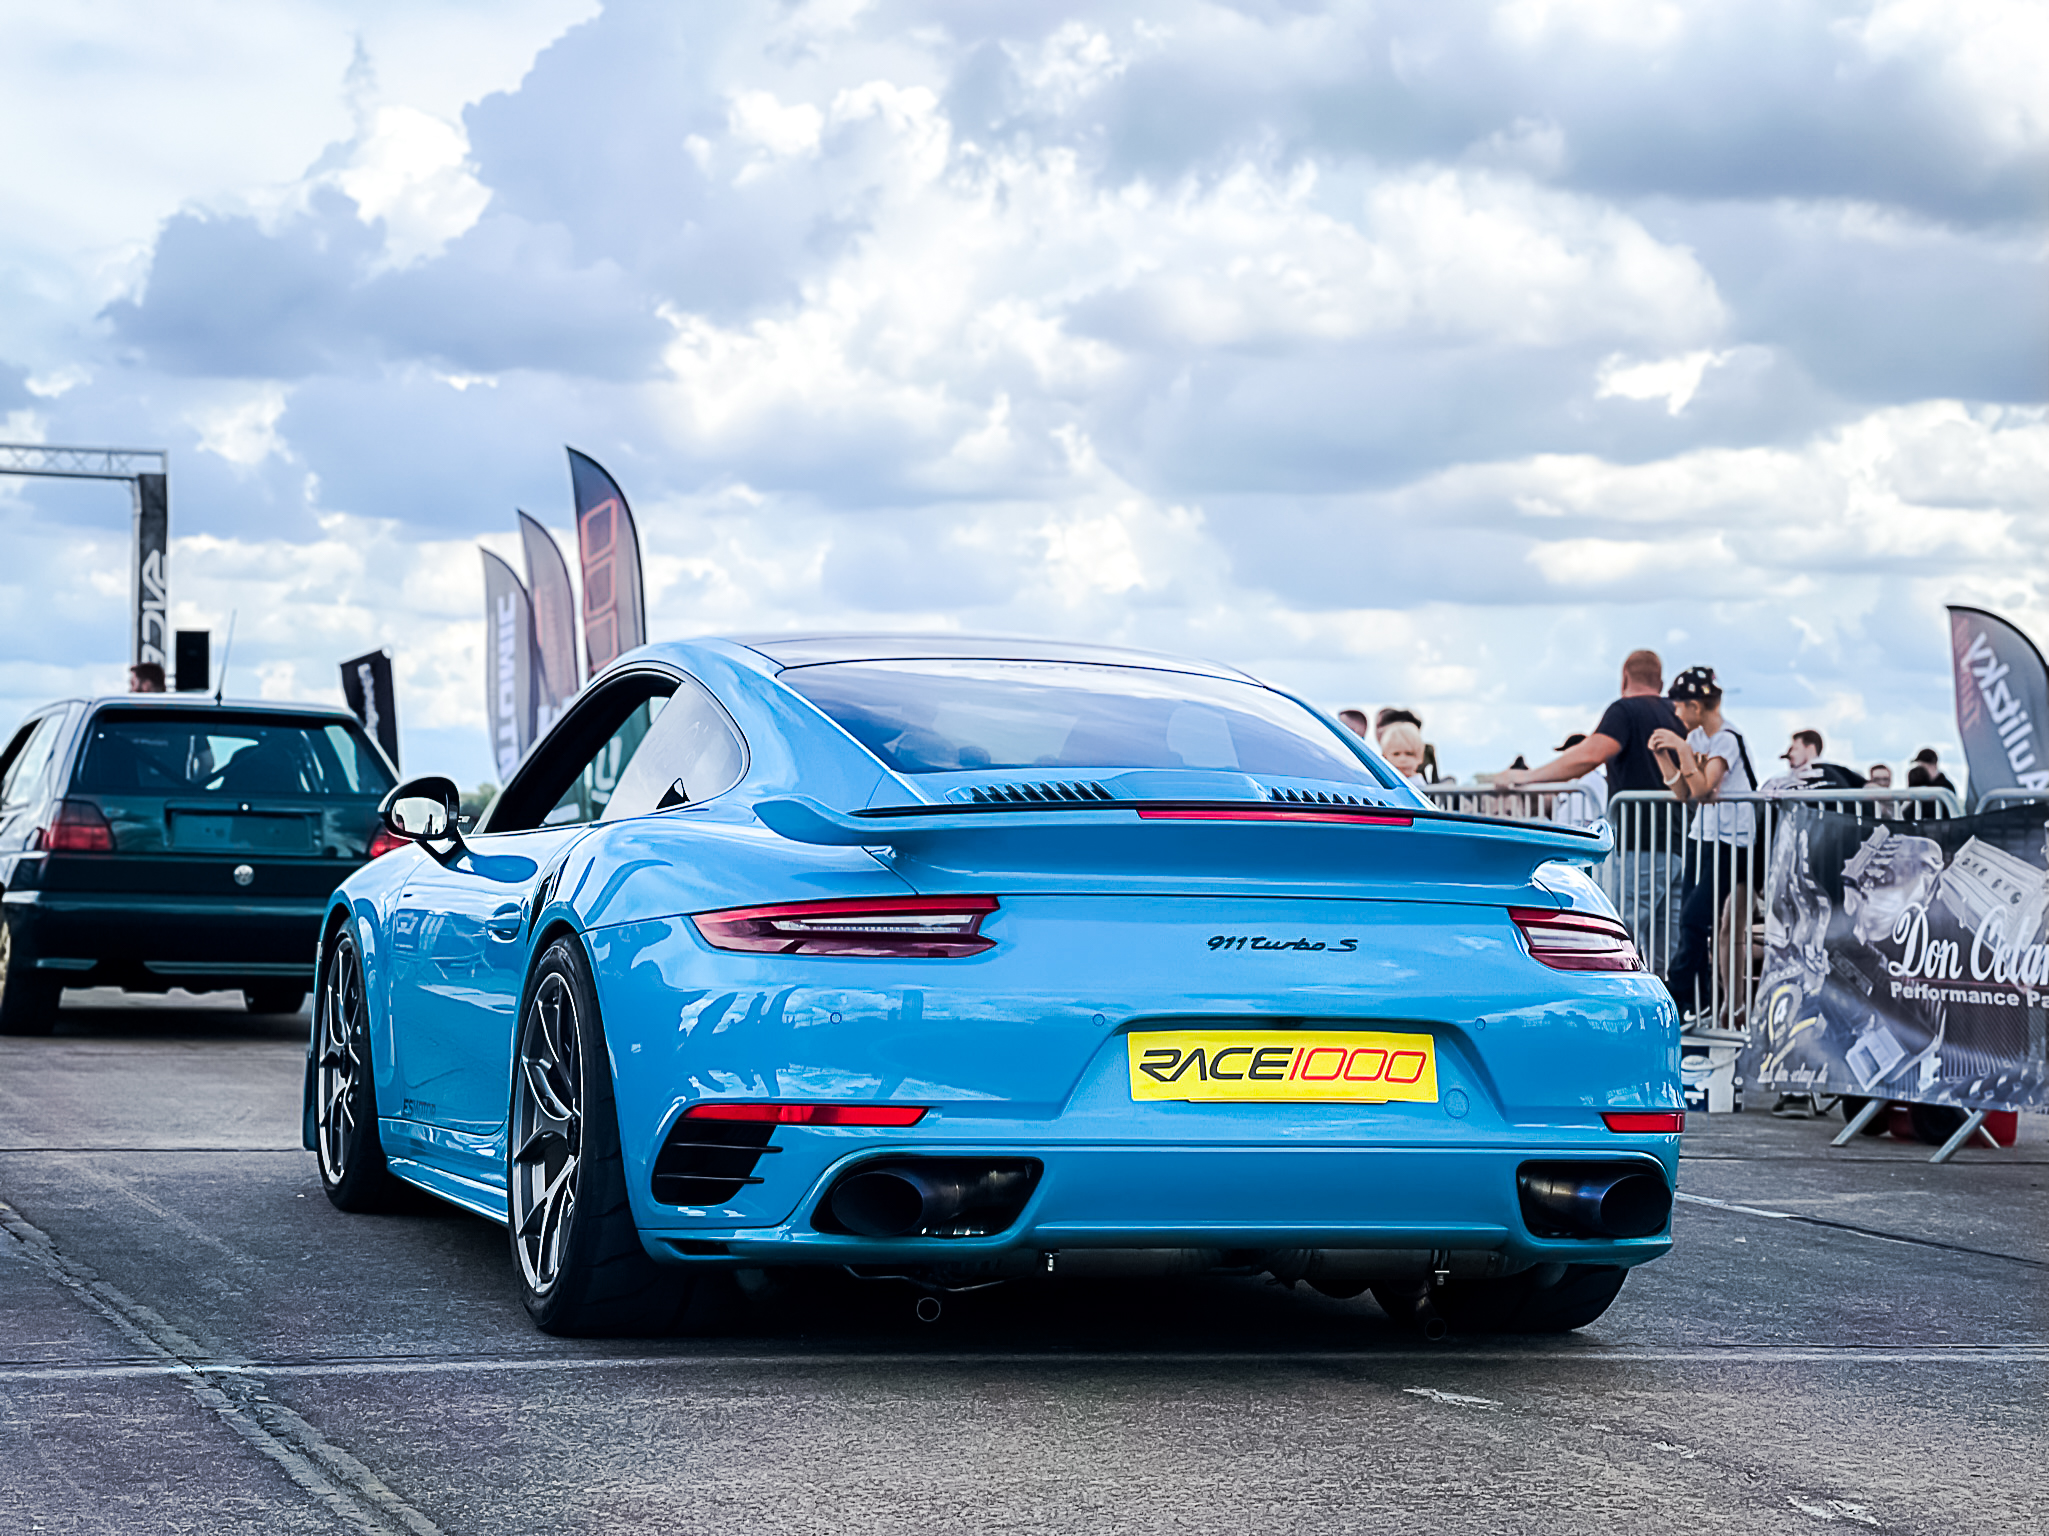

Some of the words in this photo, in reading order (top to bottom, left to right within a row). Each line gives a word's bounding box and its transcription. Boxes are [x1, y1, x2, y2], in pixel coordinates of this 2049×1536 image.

[1208, 936, 1247, 951] 911
[1328, 938, 1358, 952] S
[1888, 902, 1962, 980] Don
[1891, 981, 2019, 1006] Performance
[1139, 1047, 1427, 1084] RACE1000
